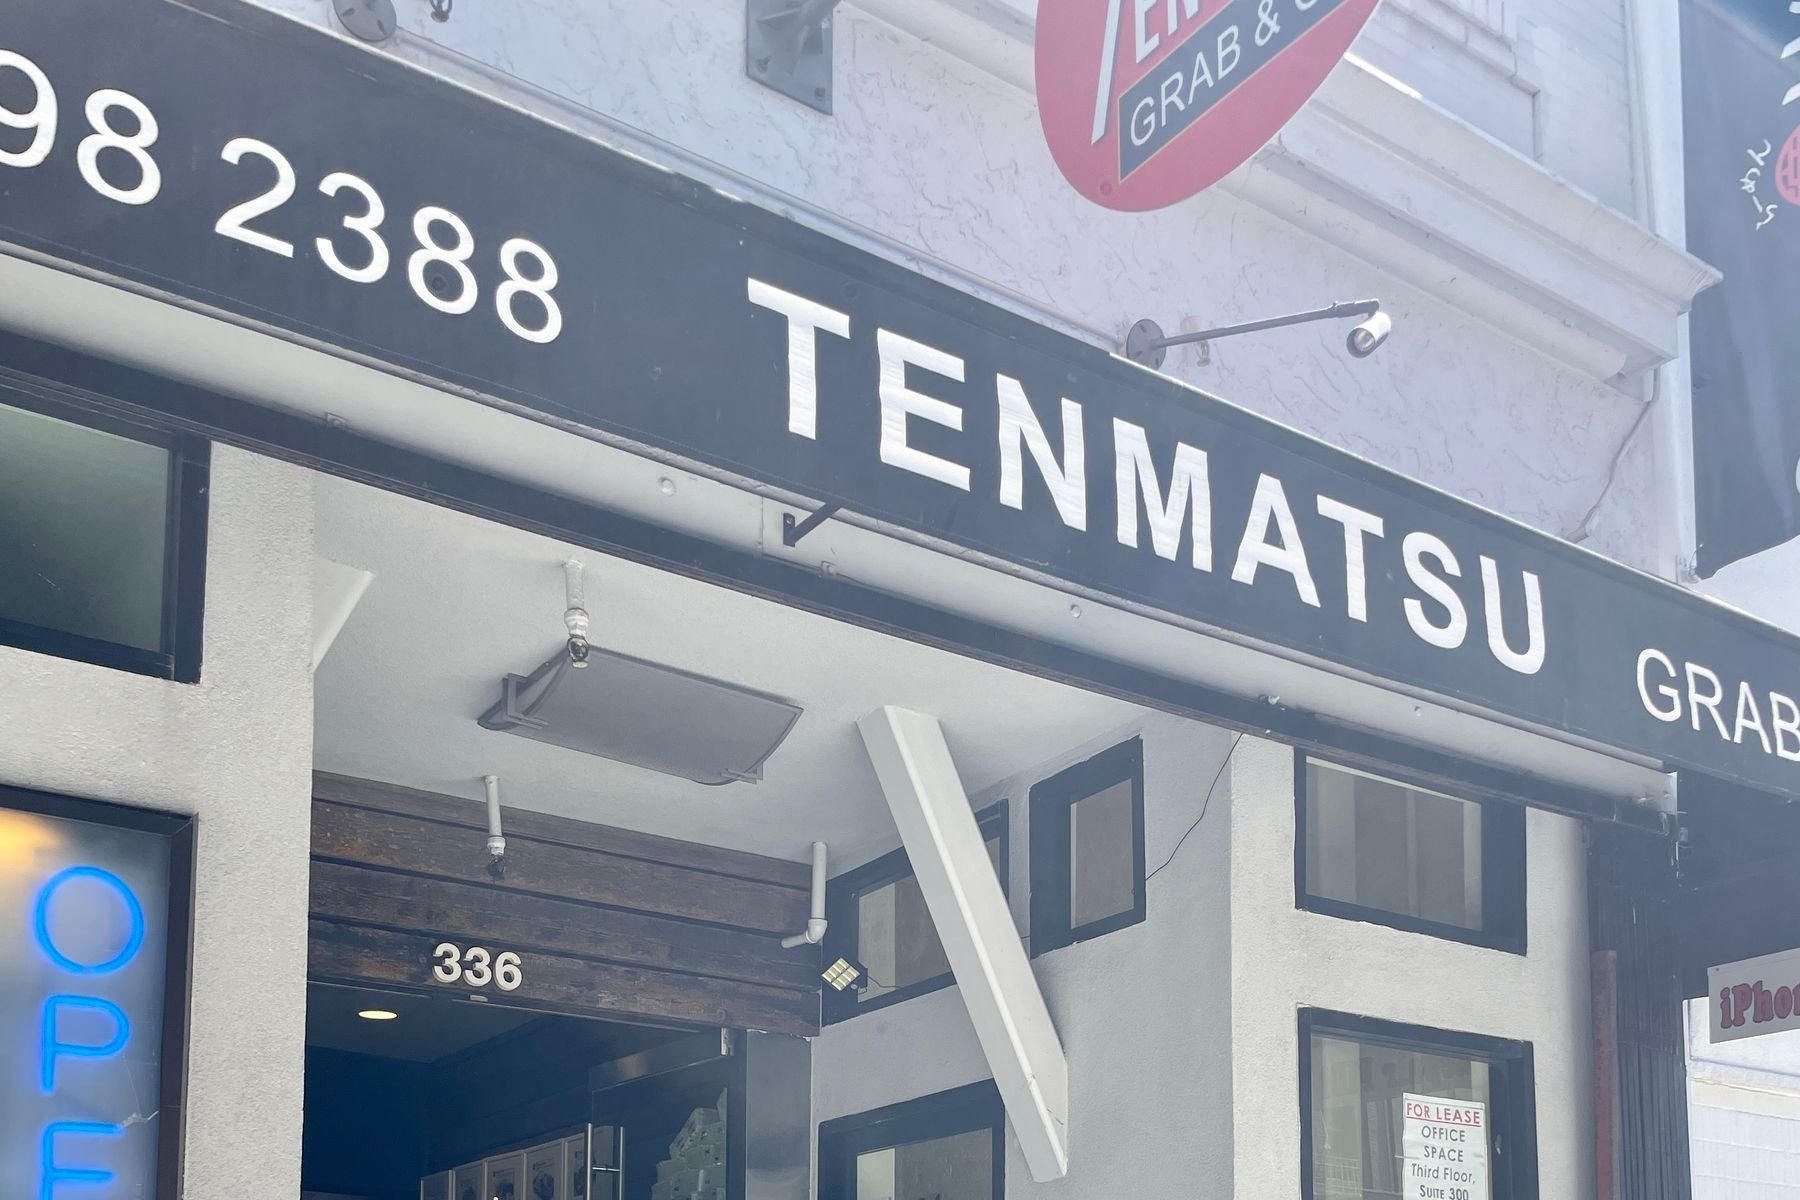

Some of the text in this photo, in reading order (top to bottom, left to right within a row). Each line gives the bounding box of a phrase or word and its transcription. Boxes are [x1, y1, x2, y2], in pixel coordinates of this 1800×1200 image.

[1131, 0, 1280, 146] GRAB &
[0, 50, 562, 343] 98 2388
[747, 278, 1545, 675] TENMATSU
[1637, 648, 1800, 762] GRAB
[432, 942, 522, 991] 336
[1406, 1103, 1480, 1124] FOR LEASE
[1421, 1126, 1465, 1142] OFFICE
[1412, 1163, 1439, 1179] Third
[1424, 1146, 1463, 1162] SPACE
